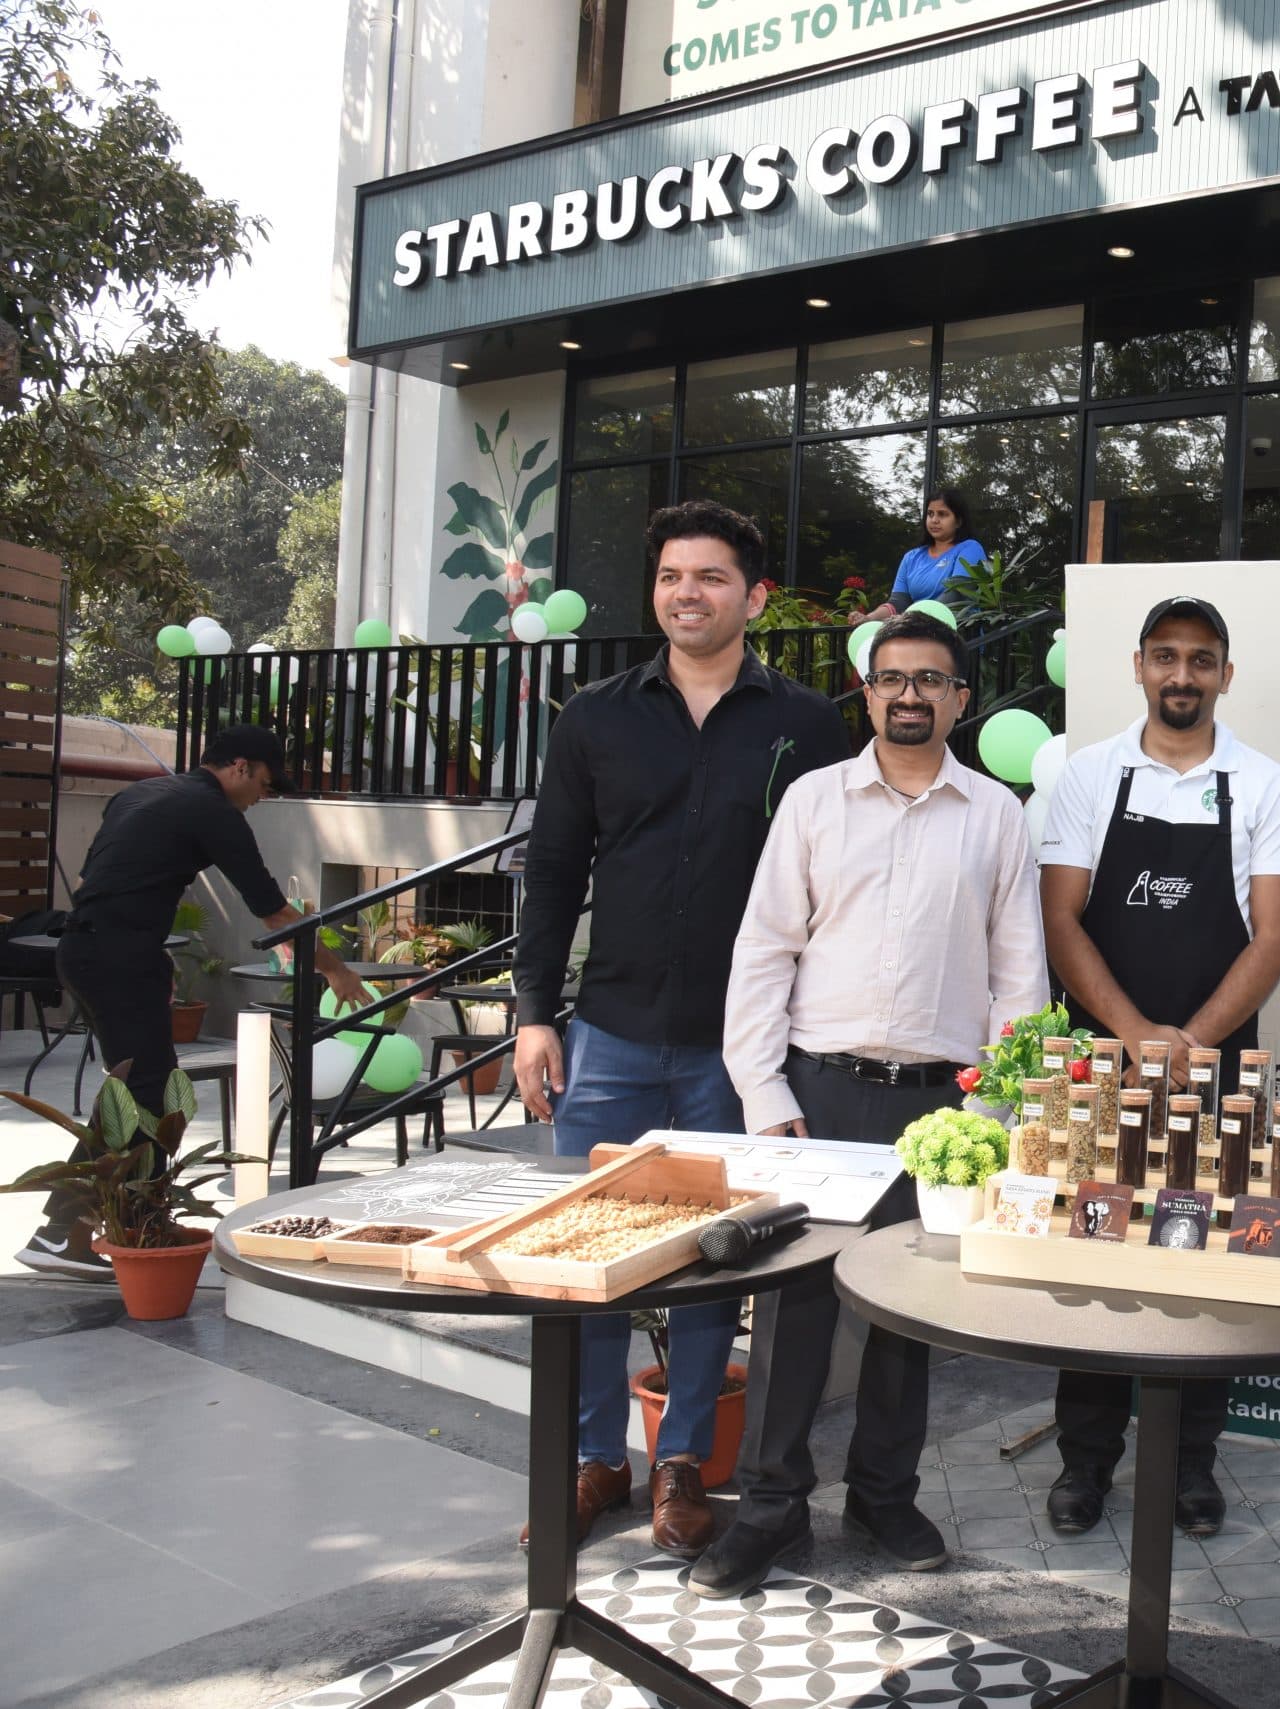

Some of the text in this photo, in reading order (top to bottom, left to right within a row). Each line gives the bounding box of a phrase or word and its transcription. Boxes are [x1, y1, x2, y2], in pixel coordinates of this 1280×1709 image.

[663, 17, 782, 77] COMES
[790, 4, 838, 43] TO
[393, 143, 794, 288] STARBUCKS
[805, 58, 1152, 198] COFFEE
[1173, 86, 1205, 126] A
[1150, 880, 1193, 893] COFFEE
[1161, 1201, 1207, 1212] SUMATRA
